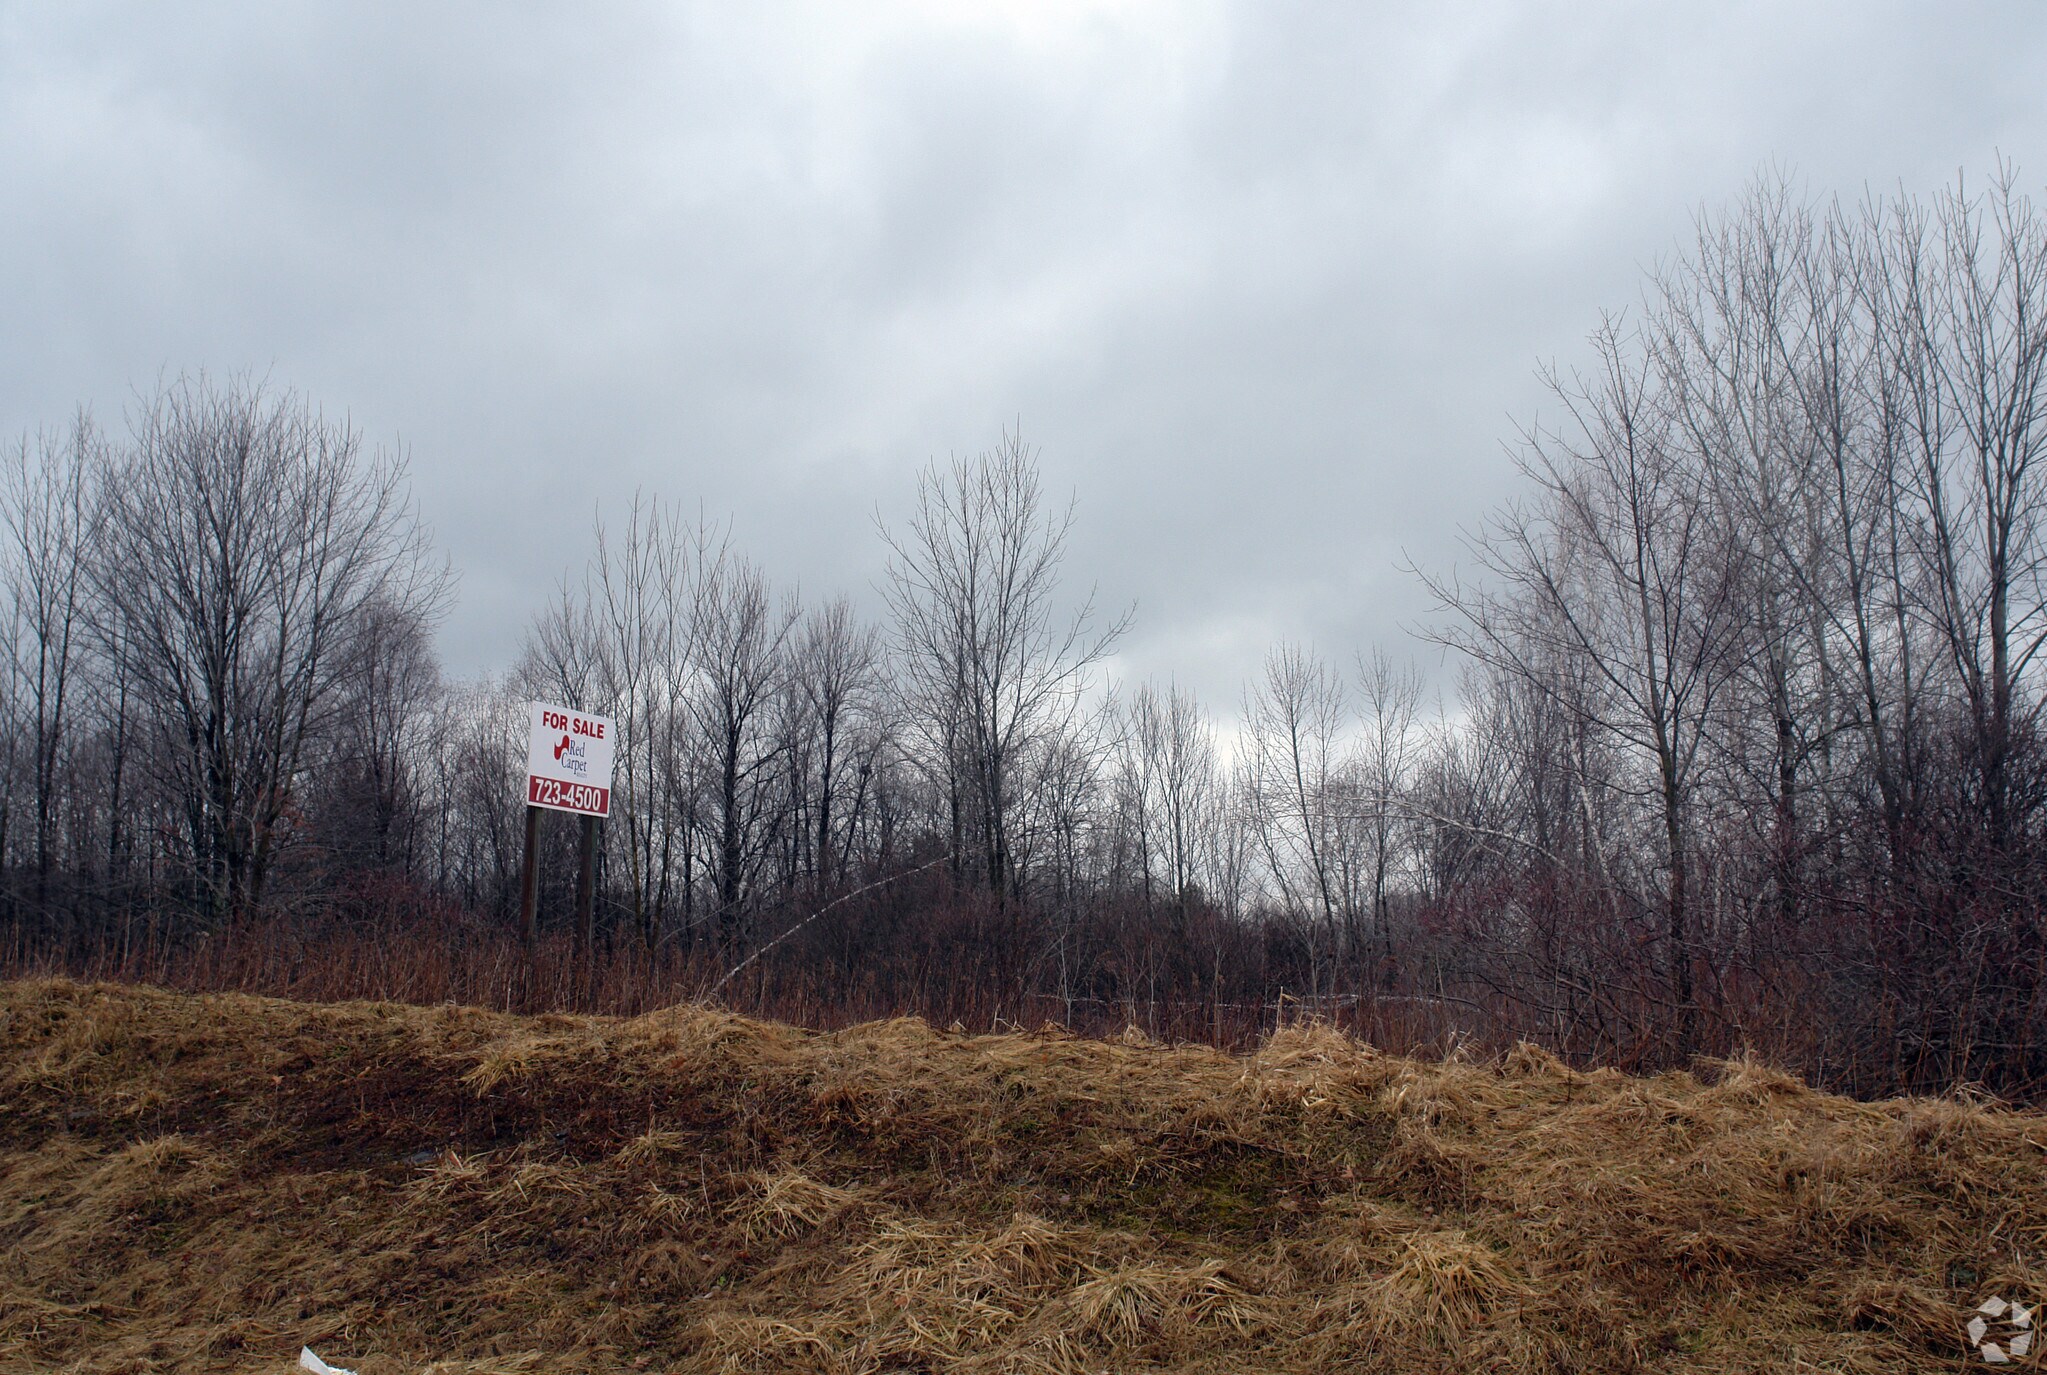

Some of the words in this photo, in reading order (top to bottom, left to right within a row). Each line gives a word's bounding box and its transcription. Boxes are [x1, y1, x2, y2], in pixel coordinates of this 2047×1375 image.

[543, 711, 568, 731] FOR
[573, 718, 604, 739] SALE
[569, 740, 585, 757] Red
[561, 752, 587, 774] Carpet
[535, 778, 601, 811] 723-4500
